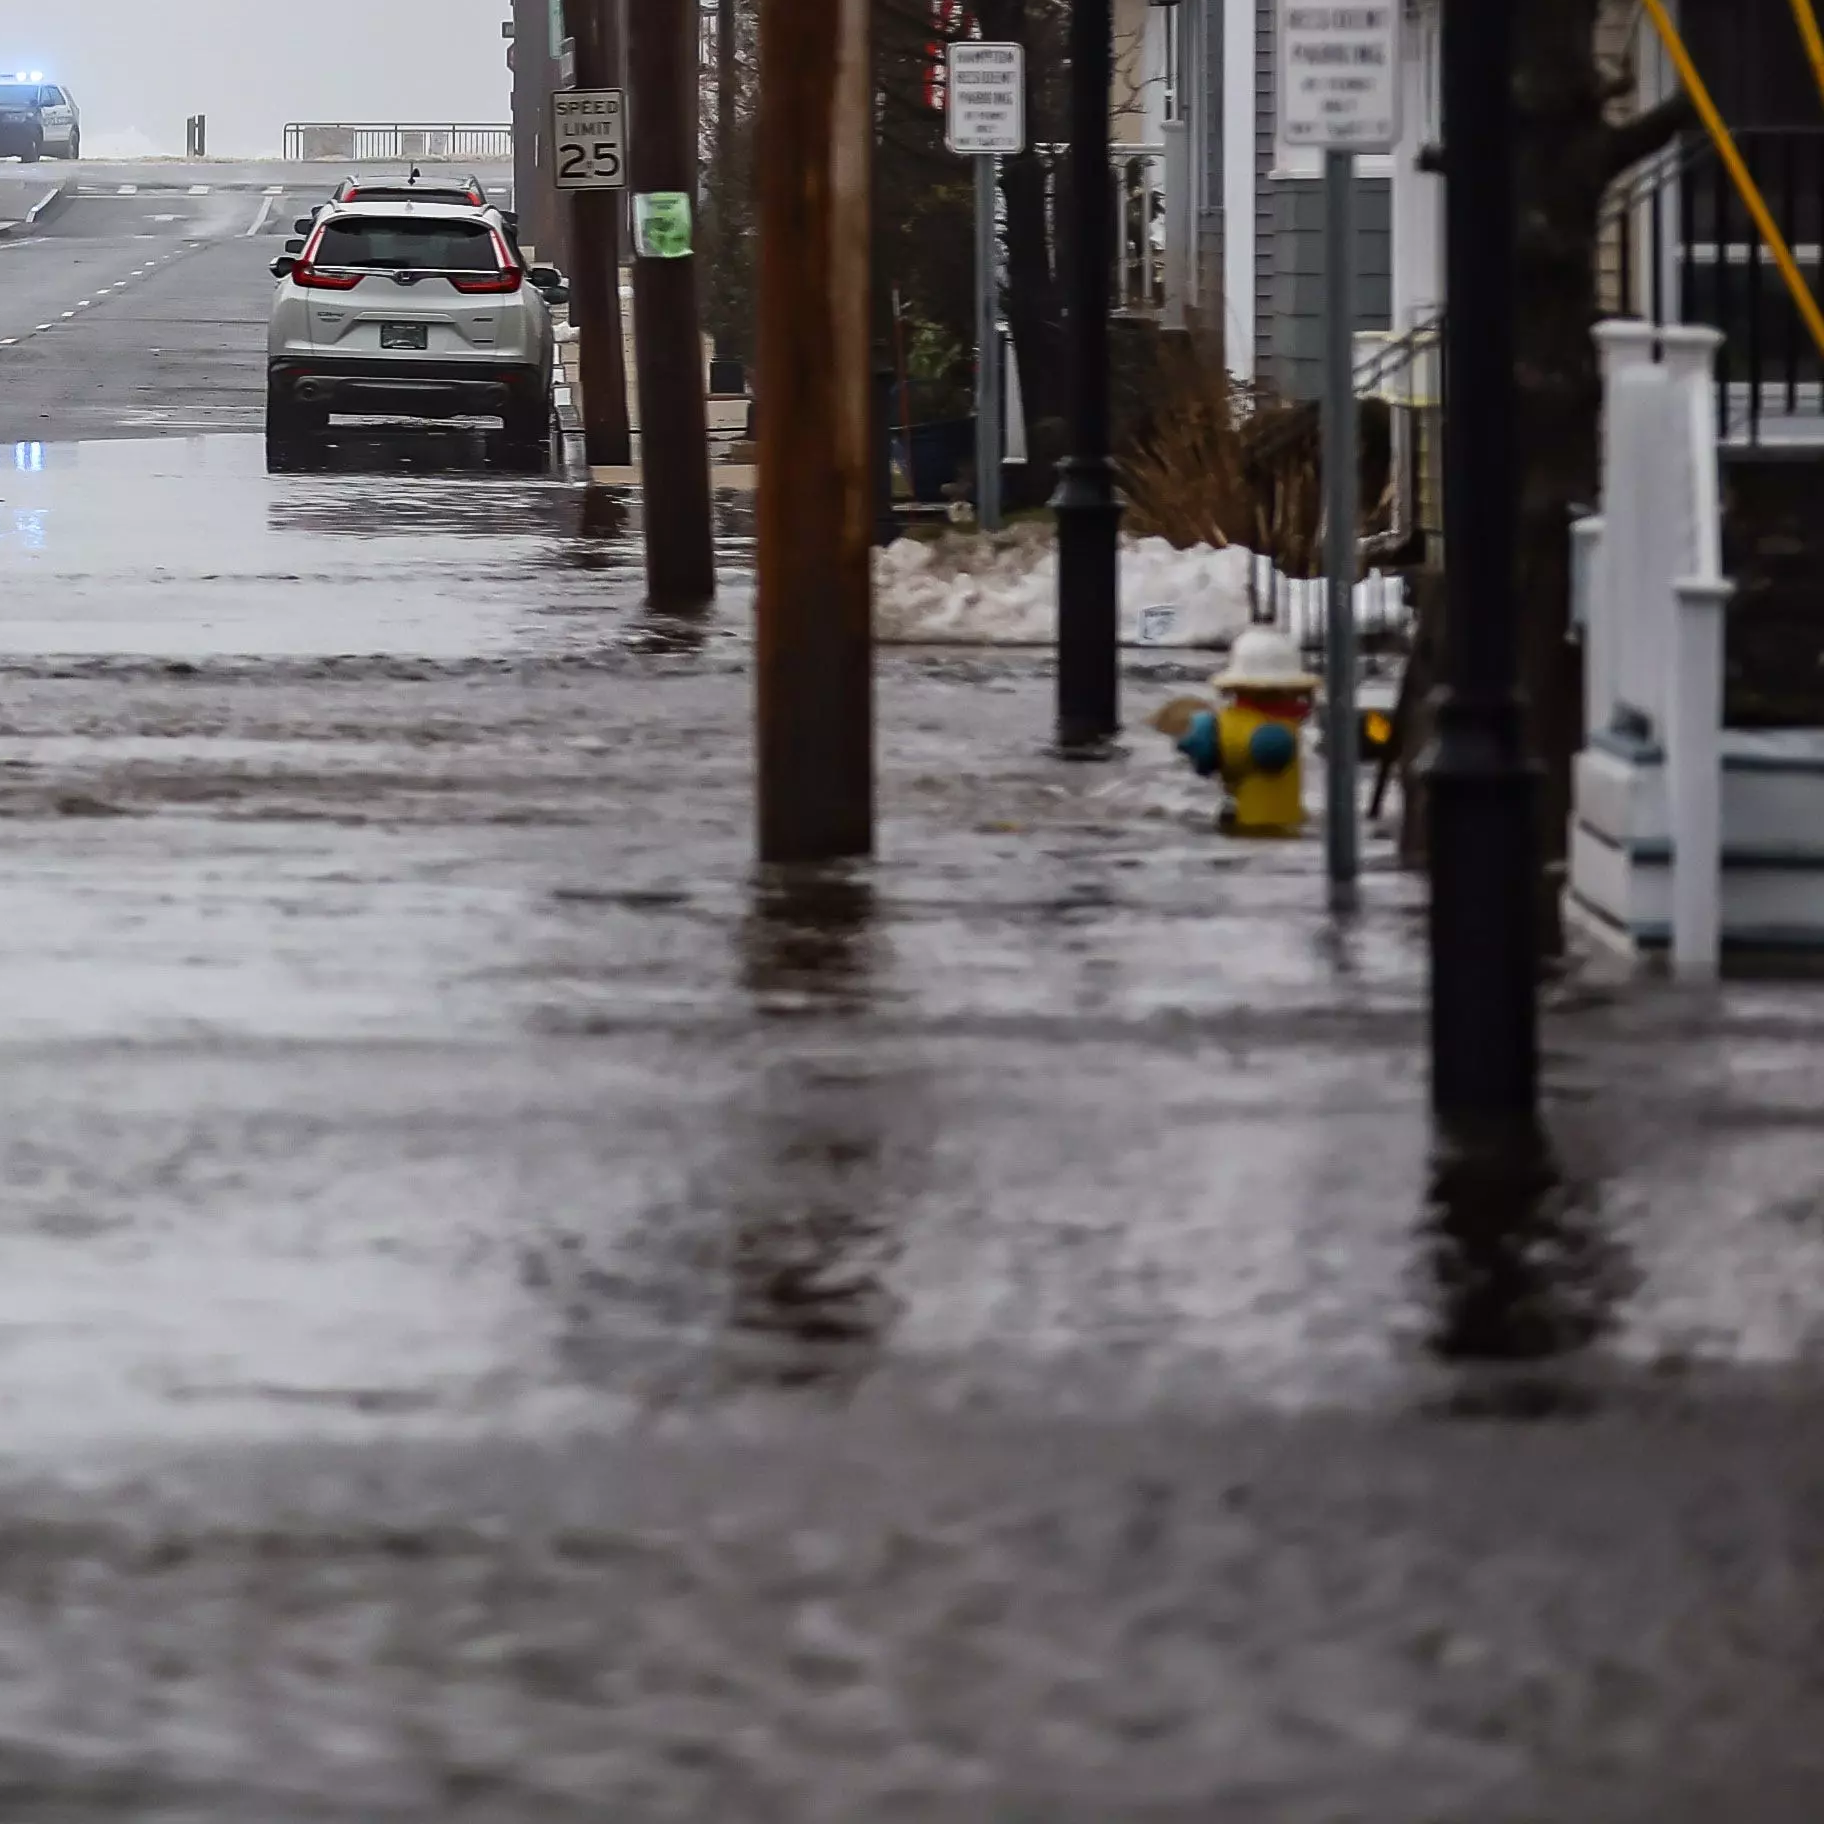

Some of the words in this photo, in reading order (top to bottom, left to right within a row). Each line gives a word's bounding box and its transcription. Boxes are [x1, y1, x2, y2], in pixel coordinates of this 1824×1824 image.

[556, 100, 619, 115] SPEED
[563, 121, 612, 136] LIMIT
[559, 142, 620, 179] 25
